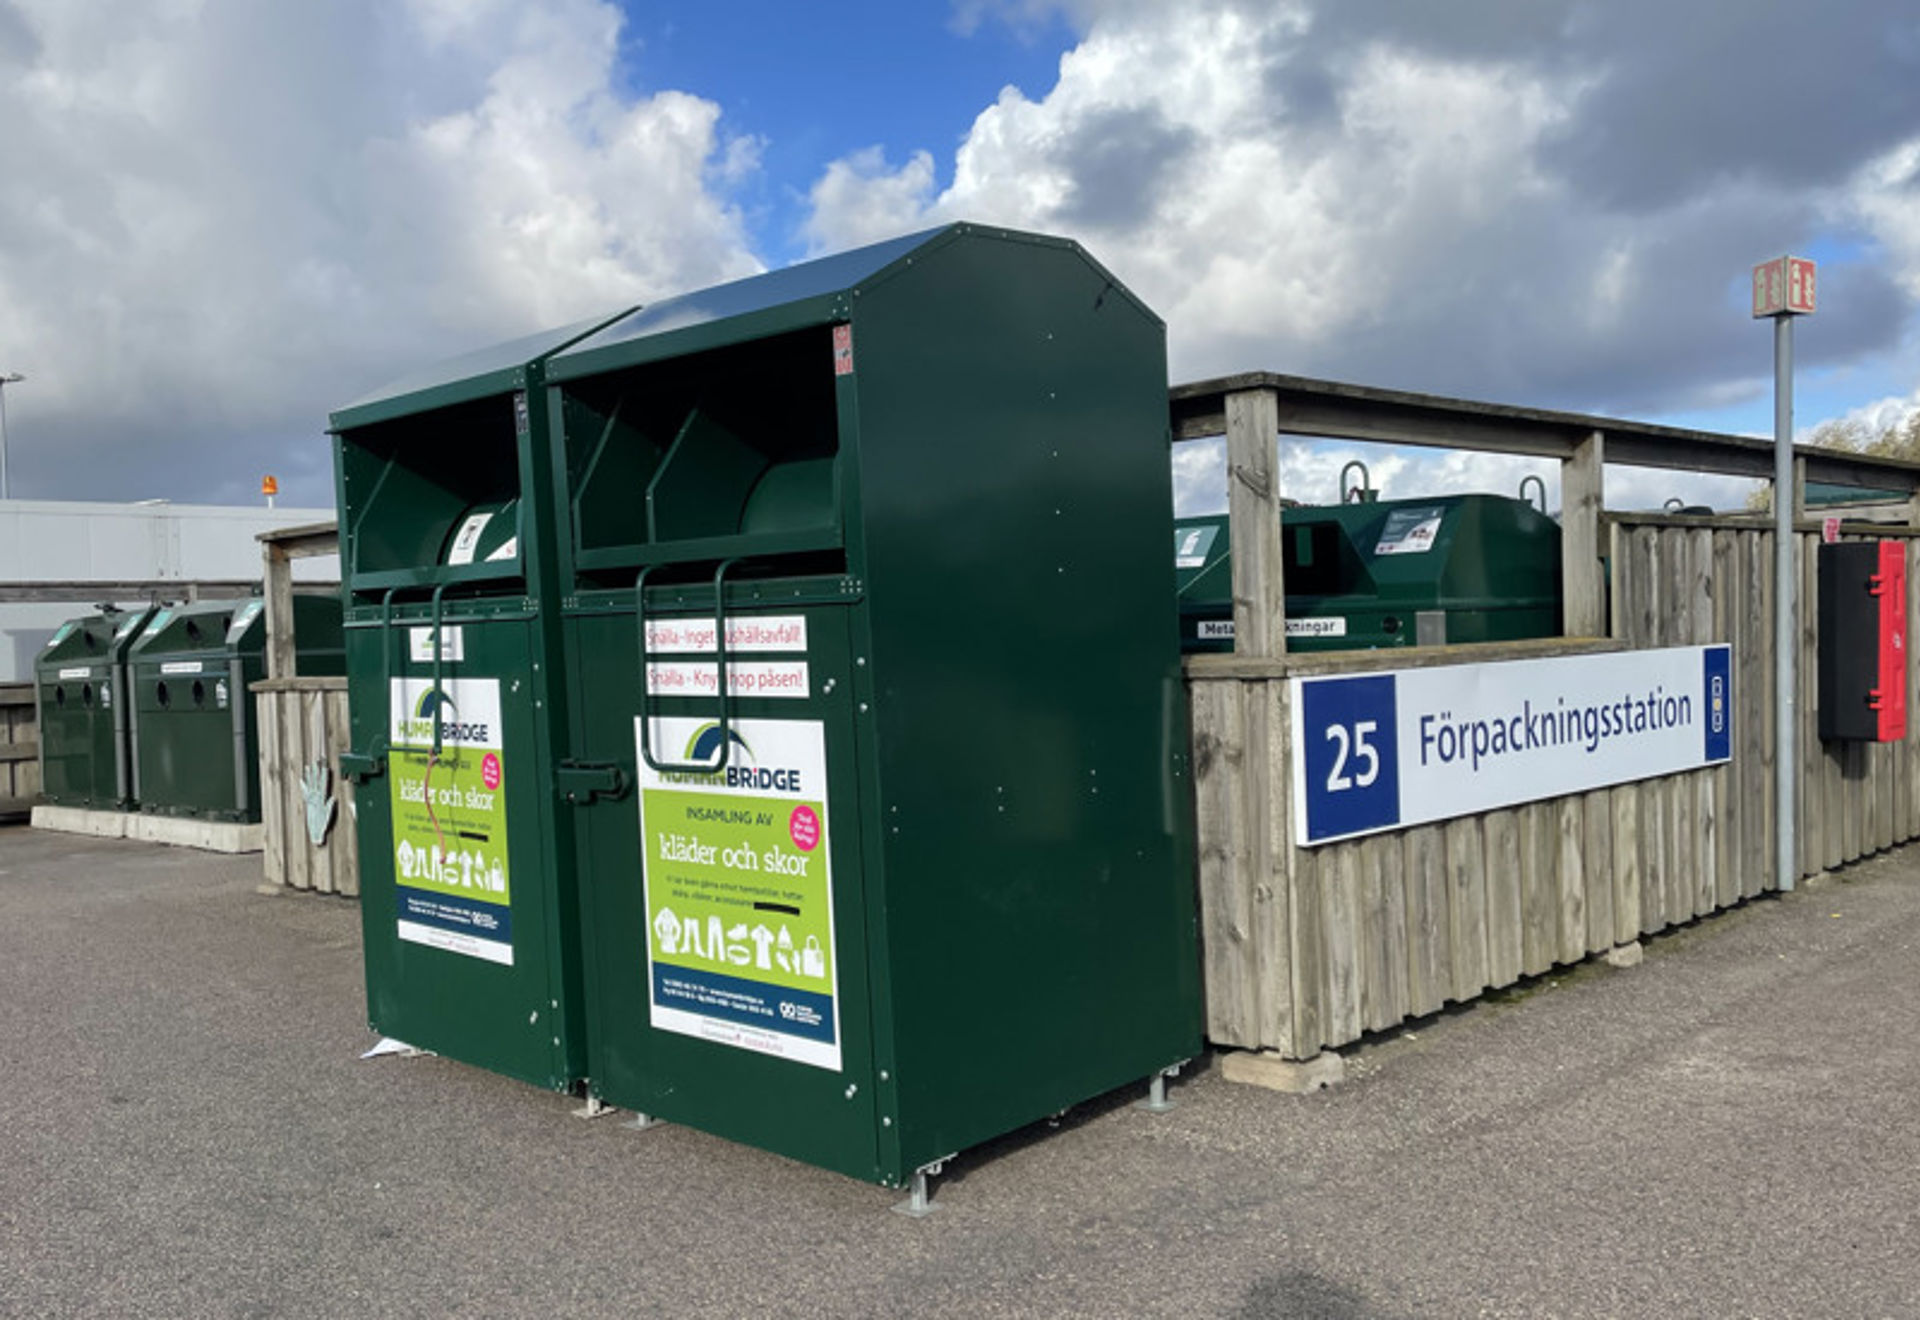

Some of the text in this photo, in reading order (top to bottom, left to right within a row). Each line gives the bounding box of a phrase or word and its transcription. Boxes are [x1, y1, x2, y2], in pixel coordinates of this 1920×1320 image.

[723, 624, 801, 644] ushållsavfall!
[758, 667, 804, 690] påsen!
[1420, 685, 1692, 771] Förpackningsstation
[1325, 721, 1380, 793] 25
[439, 783, 463, 808] och
[465, 785, 495, 811] skor
[685, 806, 774, 827] INSAMLING AV
[658, 831, 811, 877] kläder och skor
